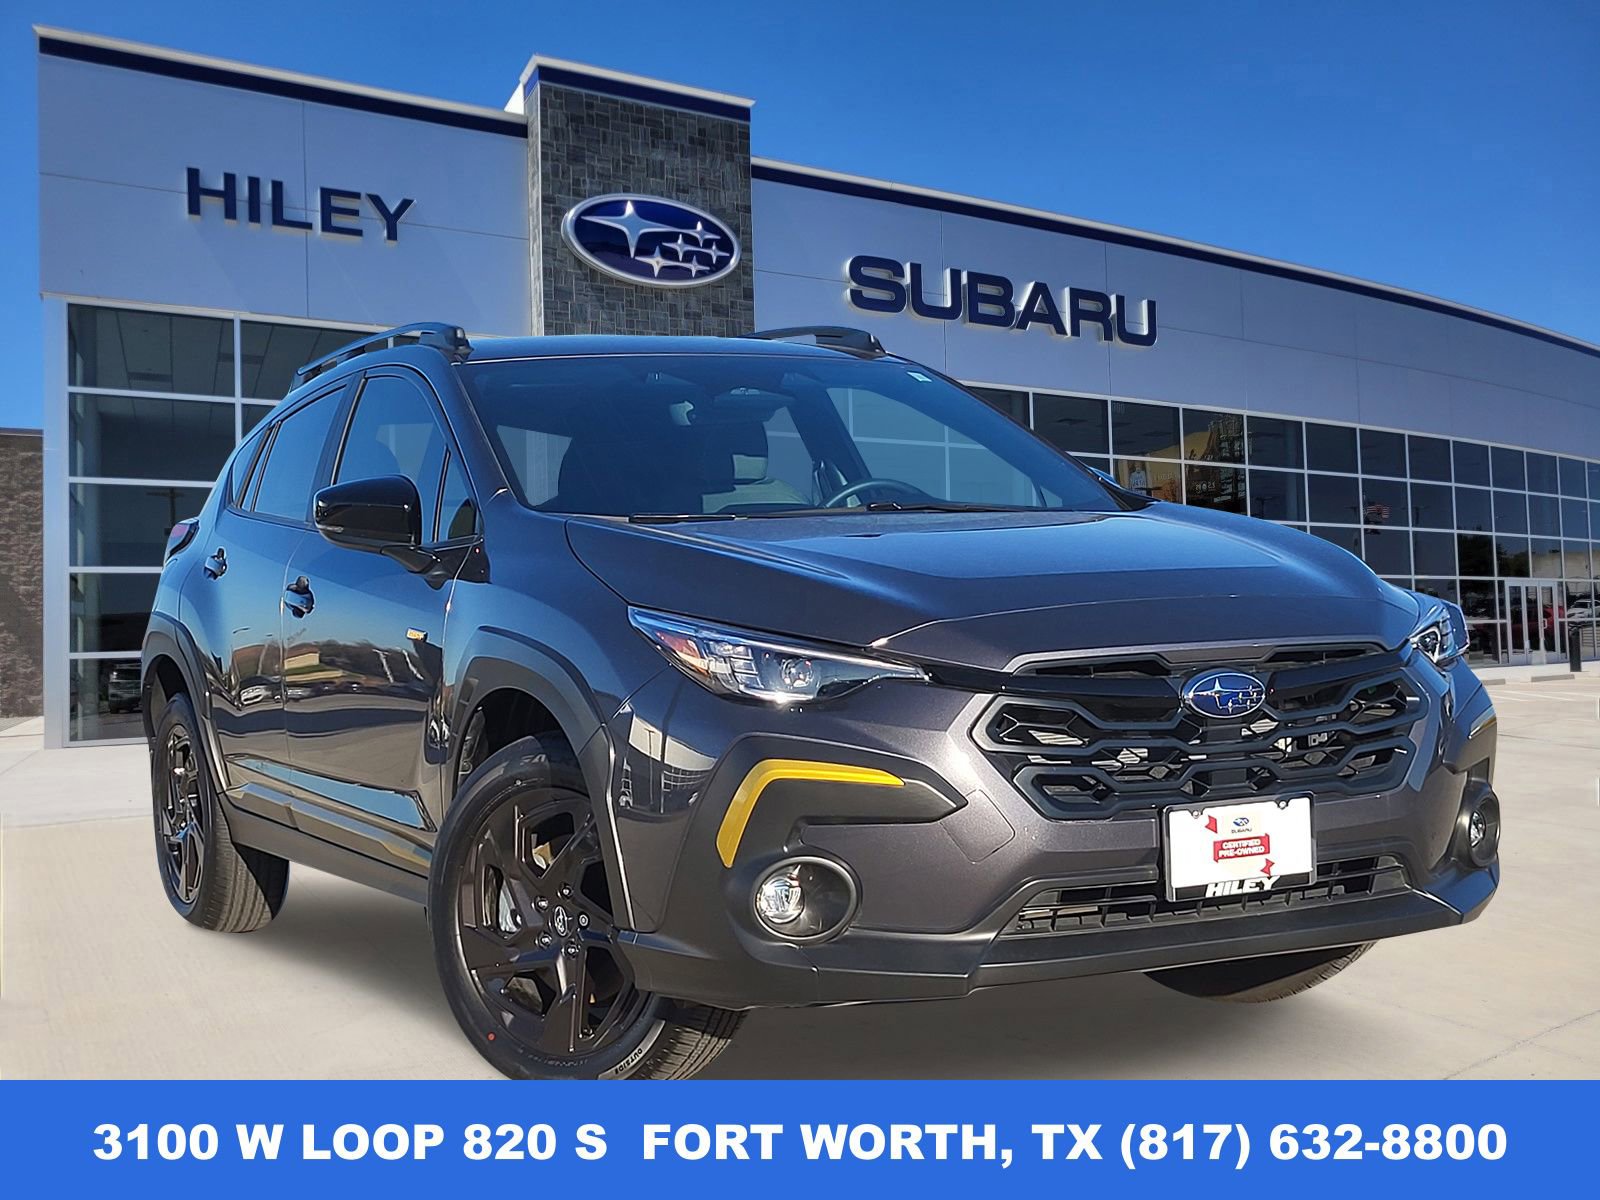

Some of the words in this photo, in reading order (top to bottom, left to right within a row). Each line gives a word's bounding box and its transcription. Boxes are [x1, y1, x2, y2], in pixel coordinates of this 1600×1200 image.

[186, 167, 415, 243] HILEY
[847, 254, 1158, 347] SUBARU
[1218, 846, 1265, 858] PRE-OWNED
[1222, 839, 1261, 849] CERTIFIED
[1205, 875, 1281, 898] HILEY
